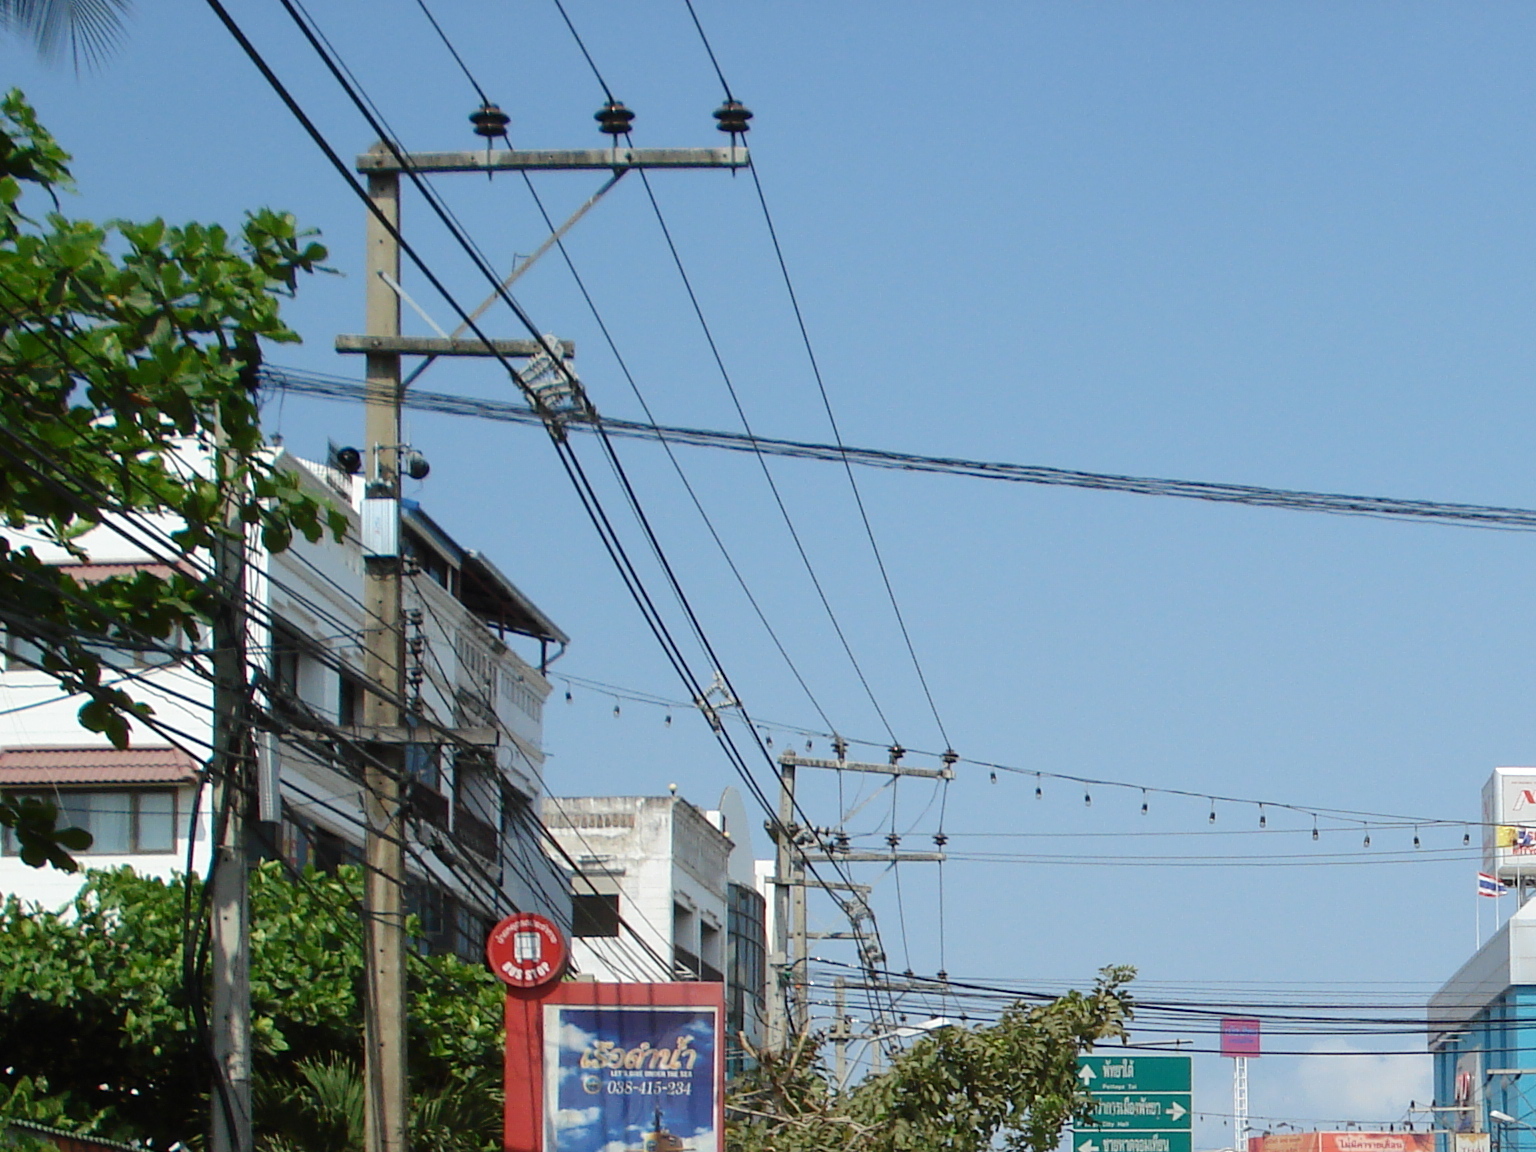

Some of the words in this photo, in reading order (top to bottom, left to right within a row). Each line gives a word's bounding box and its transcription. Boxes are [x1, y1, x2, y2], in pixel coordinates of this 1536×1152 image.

[502, 961, 523, 980] BUS
[525, 961, 550, 980] STOP
[580, 1034, 697, 1069] เรือดำน้ำ
[1102, 1059, 1134, 1078] พัทยาใต้
[607, 1080, 692, 1096] 038-415-234
